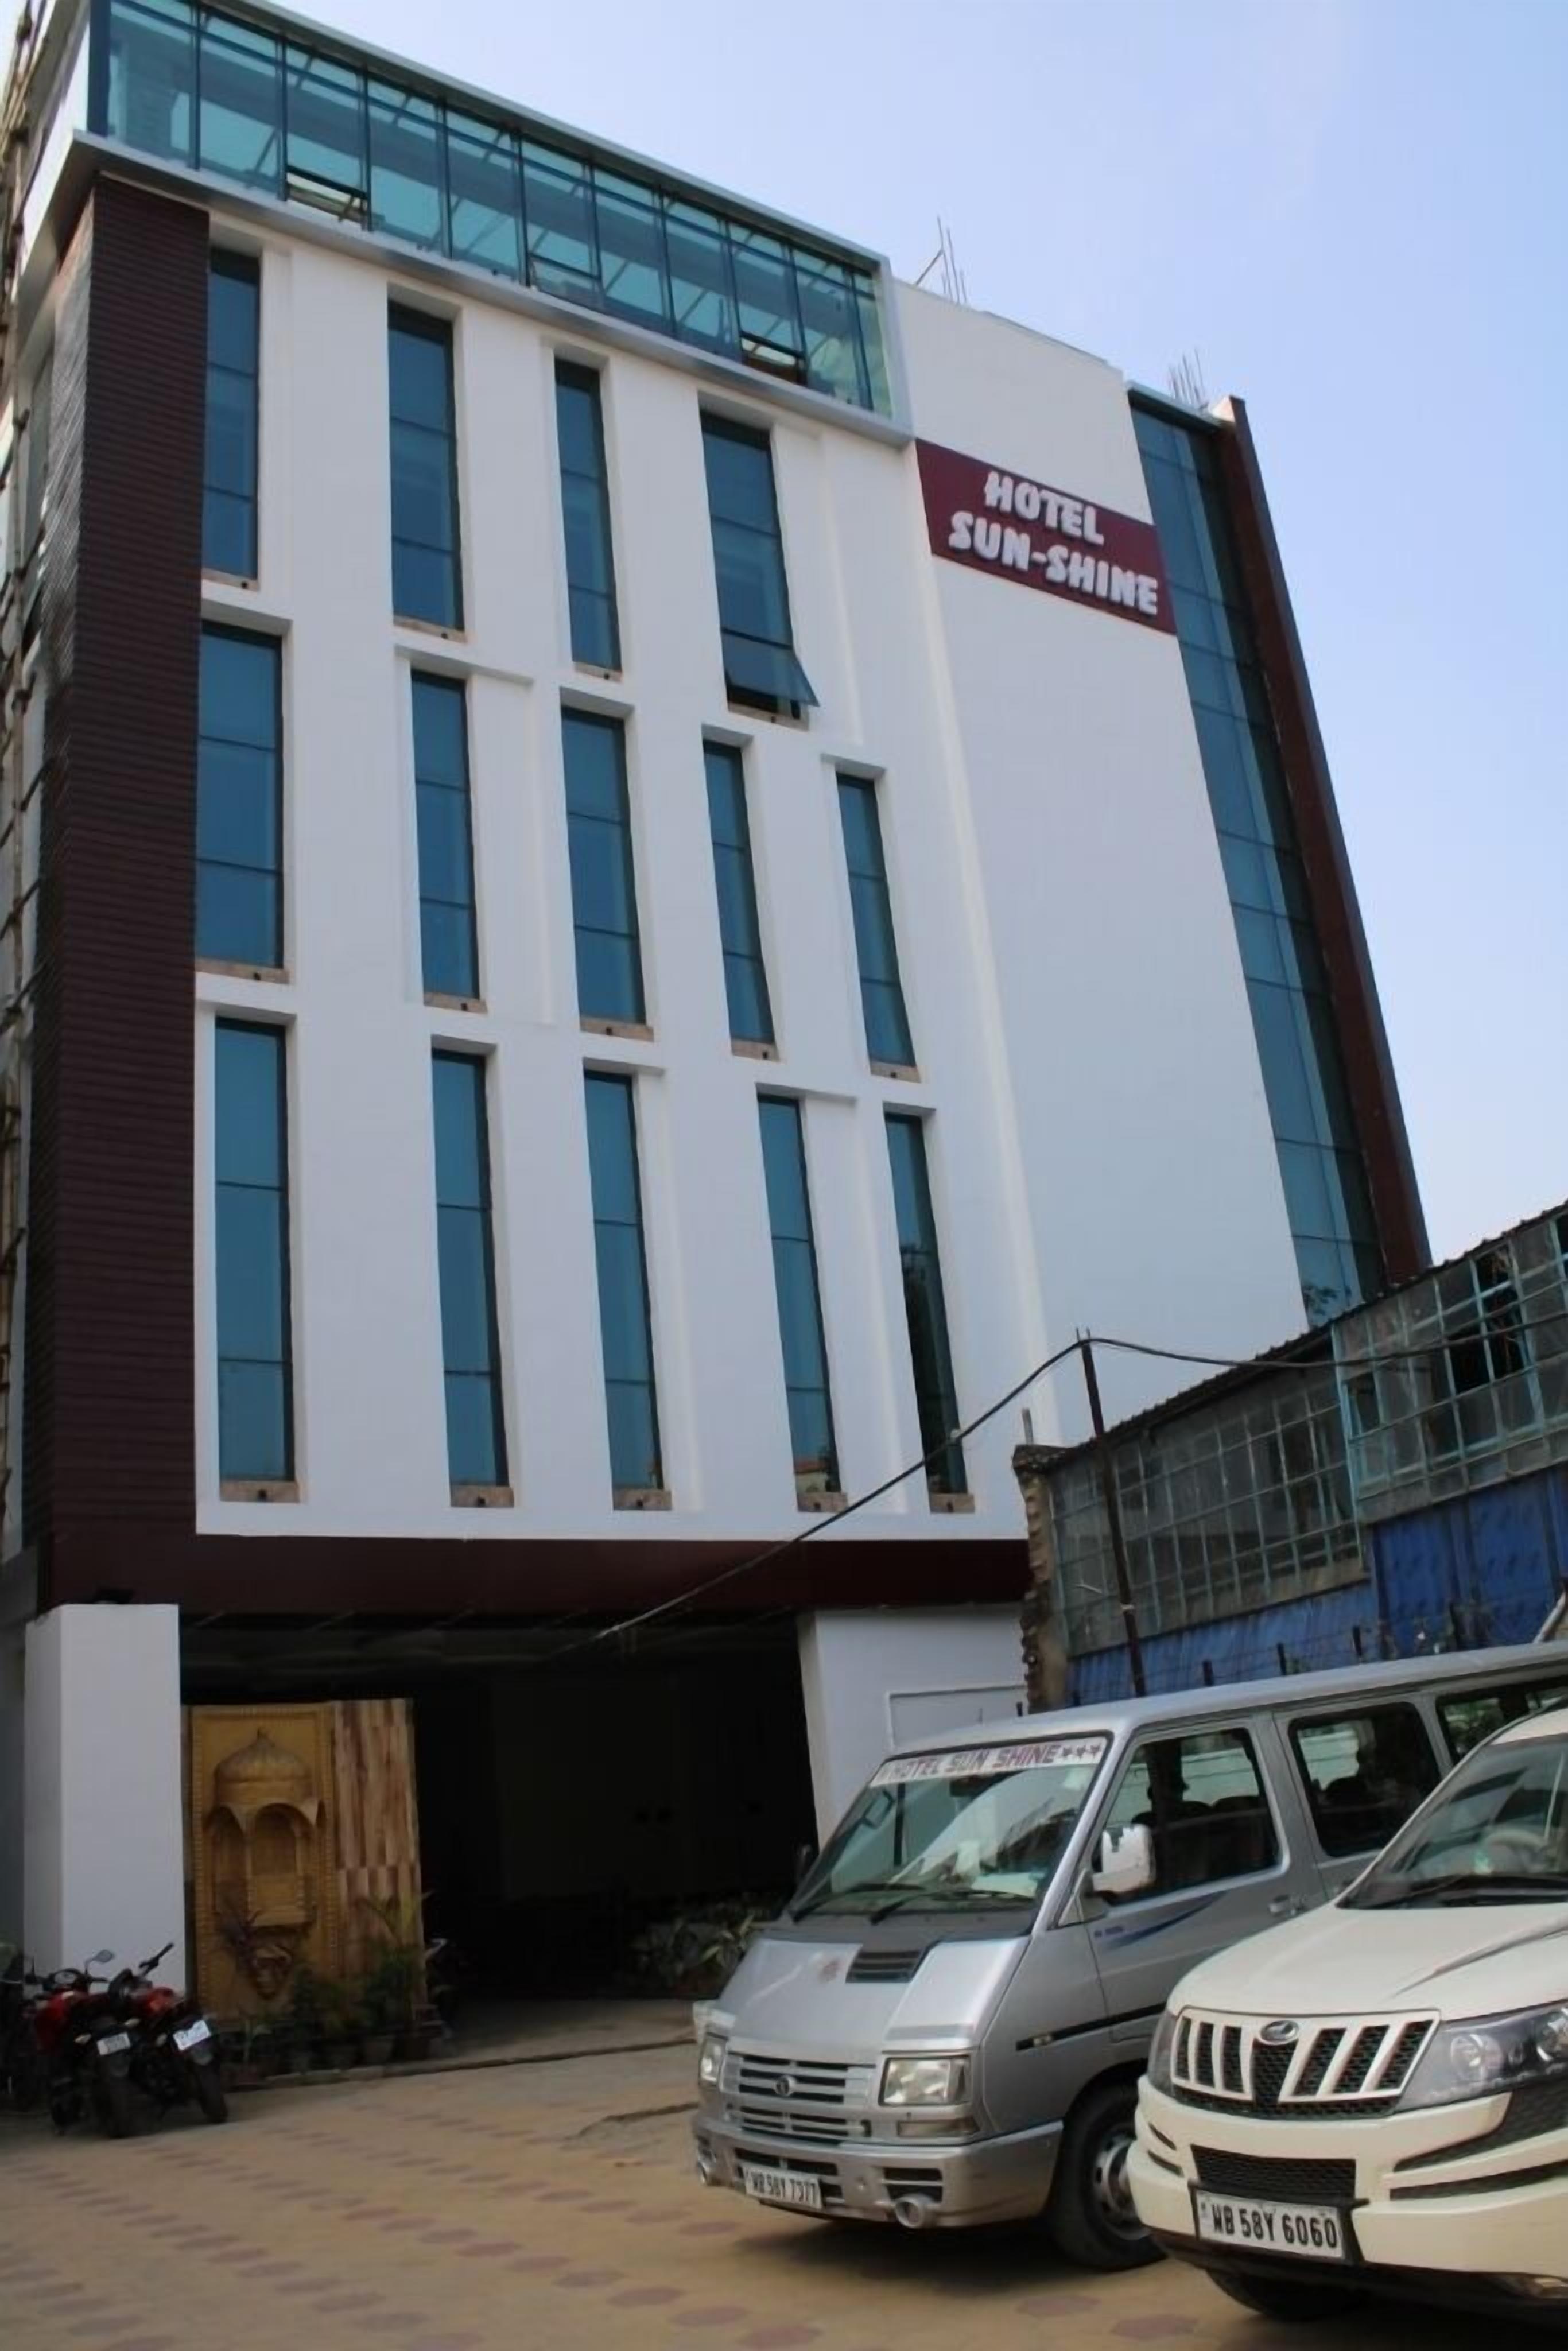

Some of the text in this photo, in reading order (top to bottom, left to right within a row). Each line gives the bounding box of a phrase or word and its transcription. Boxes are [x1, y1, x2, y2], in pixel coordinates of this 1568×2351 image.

[983, 470, 1104, 545] HOTEL
[948, 510, 1158, 615] SUN-SHINE
[992, 1743, 1062, 1768] SHINE
[1212, 2203, 1337, 2248] WB 58Y 6060
